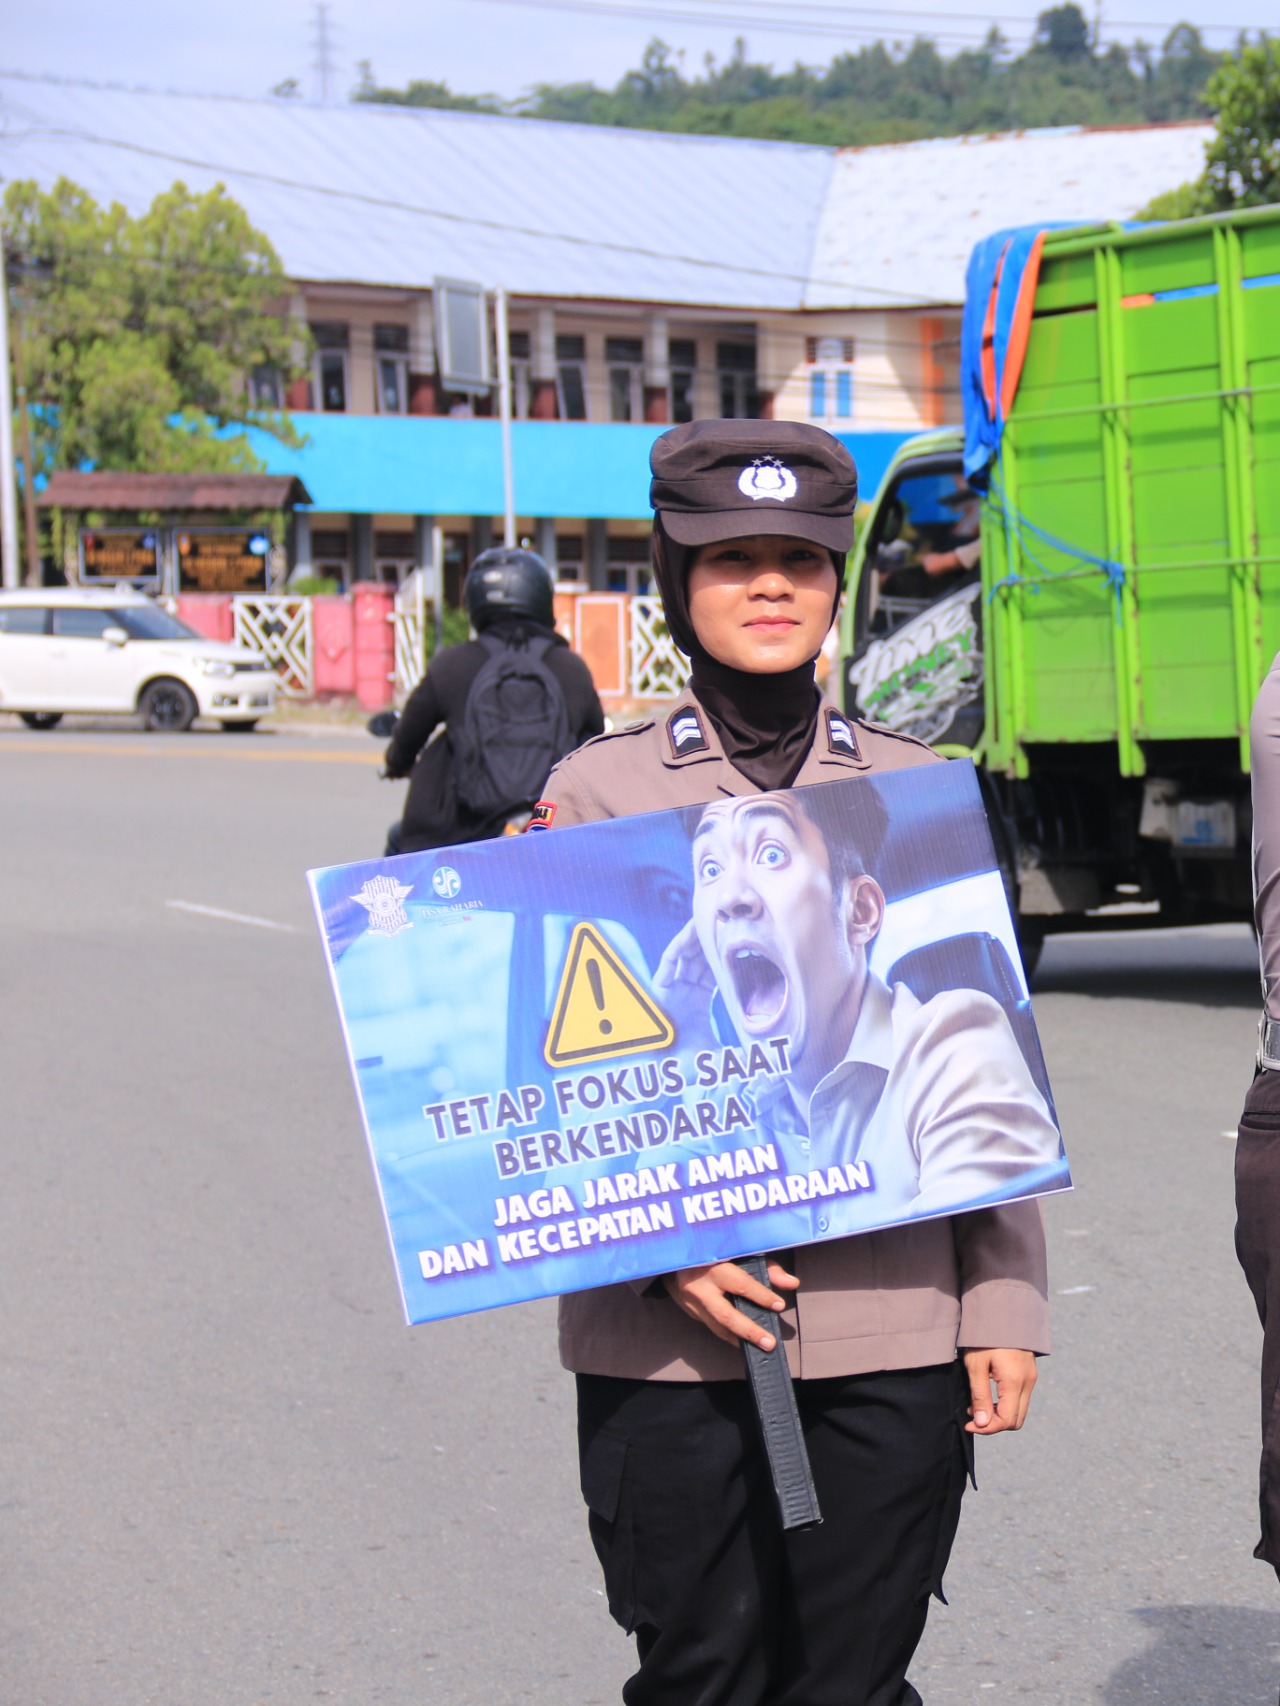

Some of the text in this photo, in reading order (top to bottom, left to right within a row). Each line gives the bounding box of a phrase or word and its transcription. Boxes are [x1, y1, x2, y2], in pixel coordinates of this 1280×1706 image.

[424, 1037, 790, 1140] TETAP FOKUS SAAT
[494, 1096, 752, 1177] BERKENDARA
[417, 1160, 872, 1279] DAN KECEPATAN KENDARAAN
[493, 1143, 779, 1227] JAGA JARAK AMAN
